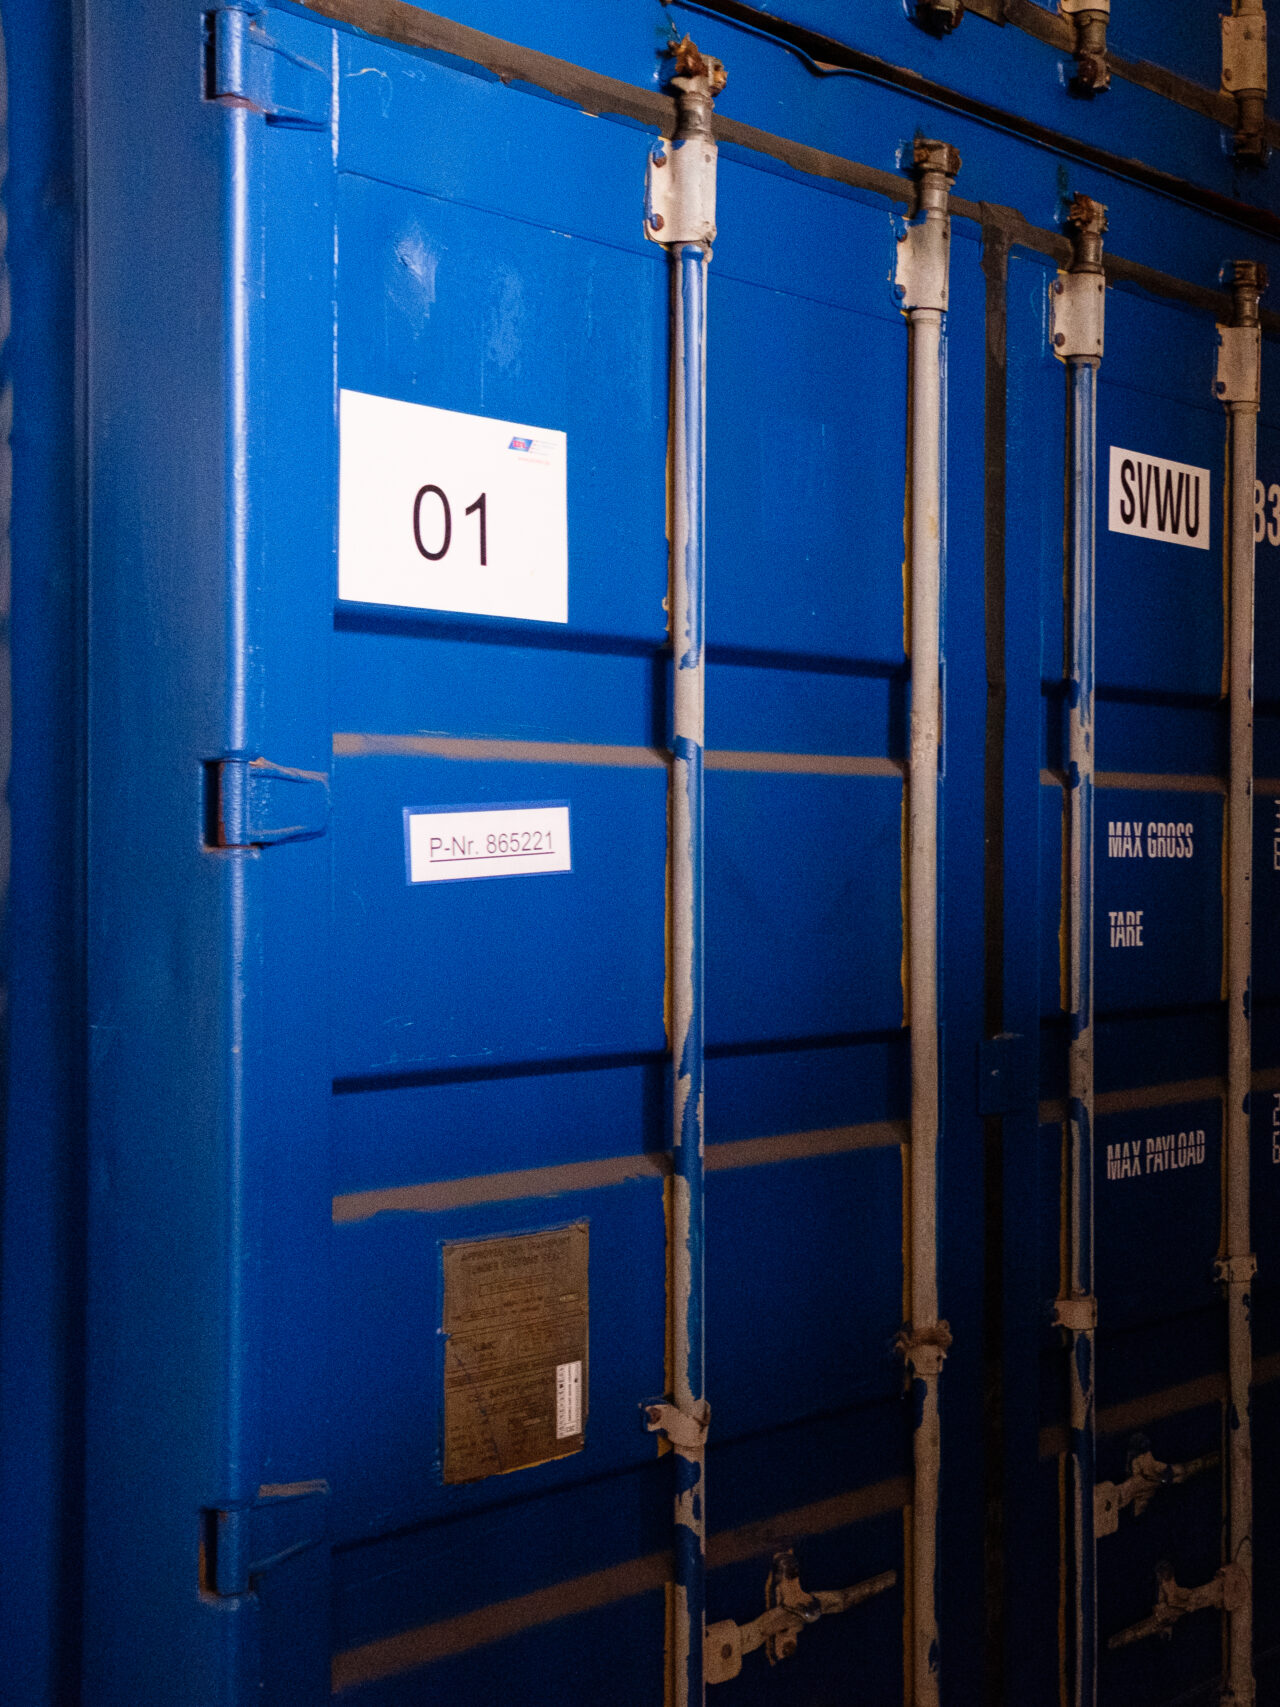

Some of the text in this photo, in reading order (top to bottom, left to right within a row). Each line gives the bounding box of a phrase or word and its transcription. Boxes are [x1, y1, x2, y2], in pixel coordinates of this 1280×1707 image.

[1120, 459, 1199, 538] SVWU
[413, 484, 487, 566] 01
[429, 830, 553, 858] P-Nr. 865221
[1108, 821, 1194, 859] MAX GROSS
[1108, 910, 1145, 949] TARE
[1107, 1129, 1206, 1181] MAX PAYLOAD
